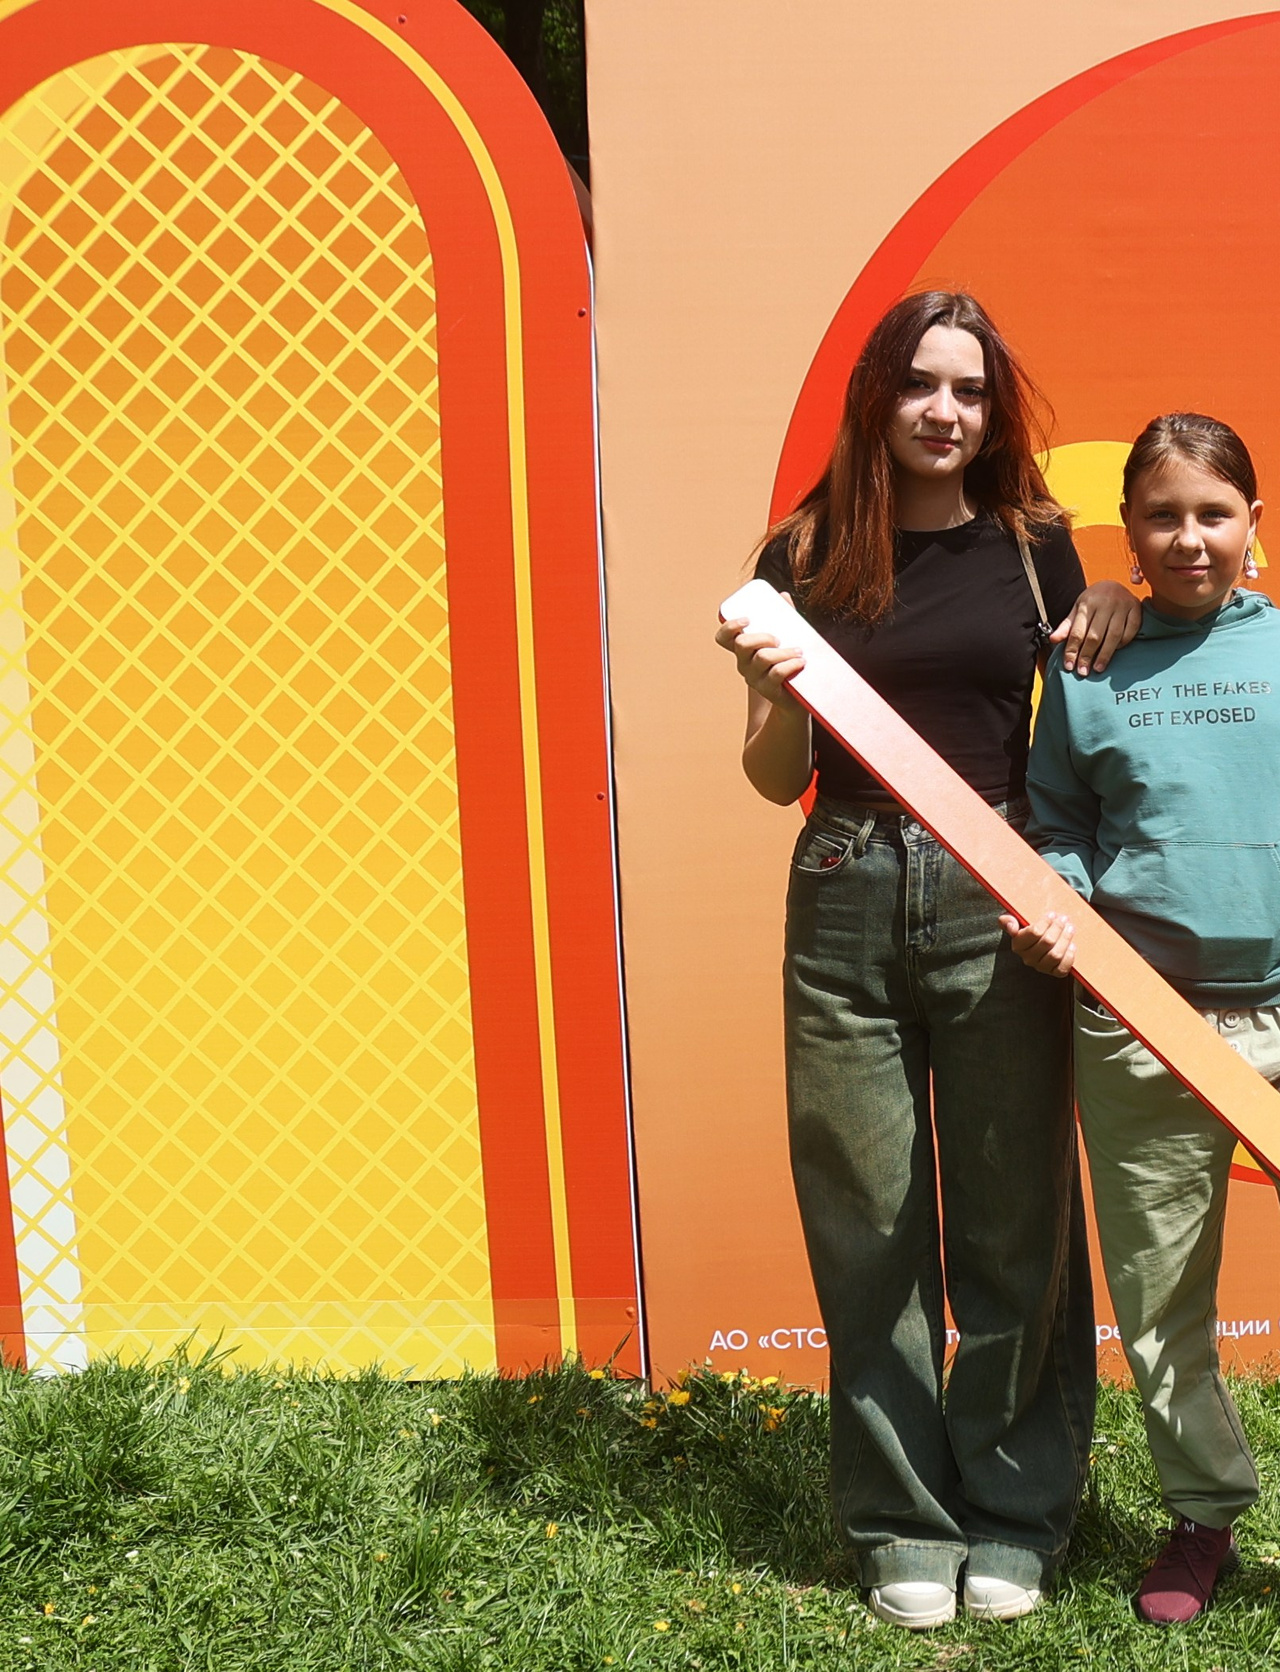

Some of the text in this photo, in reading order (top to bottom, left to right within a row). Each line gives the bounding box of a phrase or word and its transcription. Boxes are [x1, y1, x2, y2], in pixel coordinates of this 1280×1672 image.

[1115, 681, 1272, 705] PREY THE FAKES
[1128, 707, 1256, 728] GET EXPOSED
[709, 1329, 749, 1351] АО
